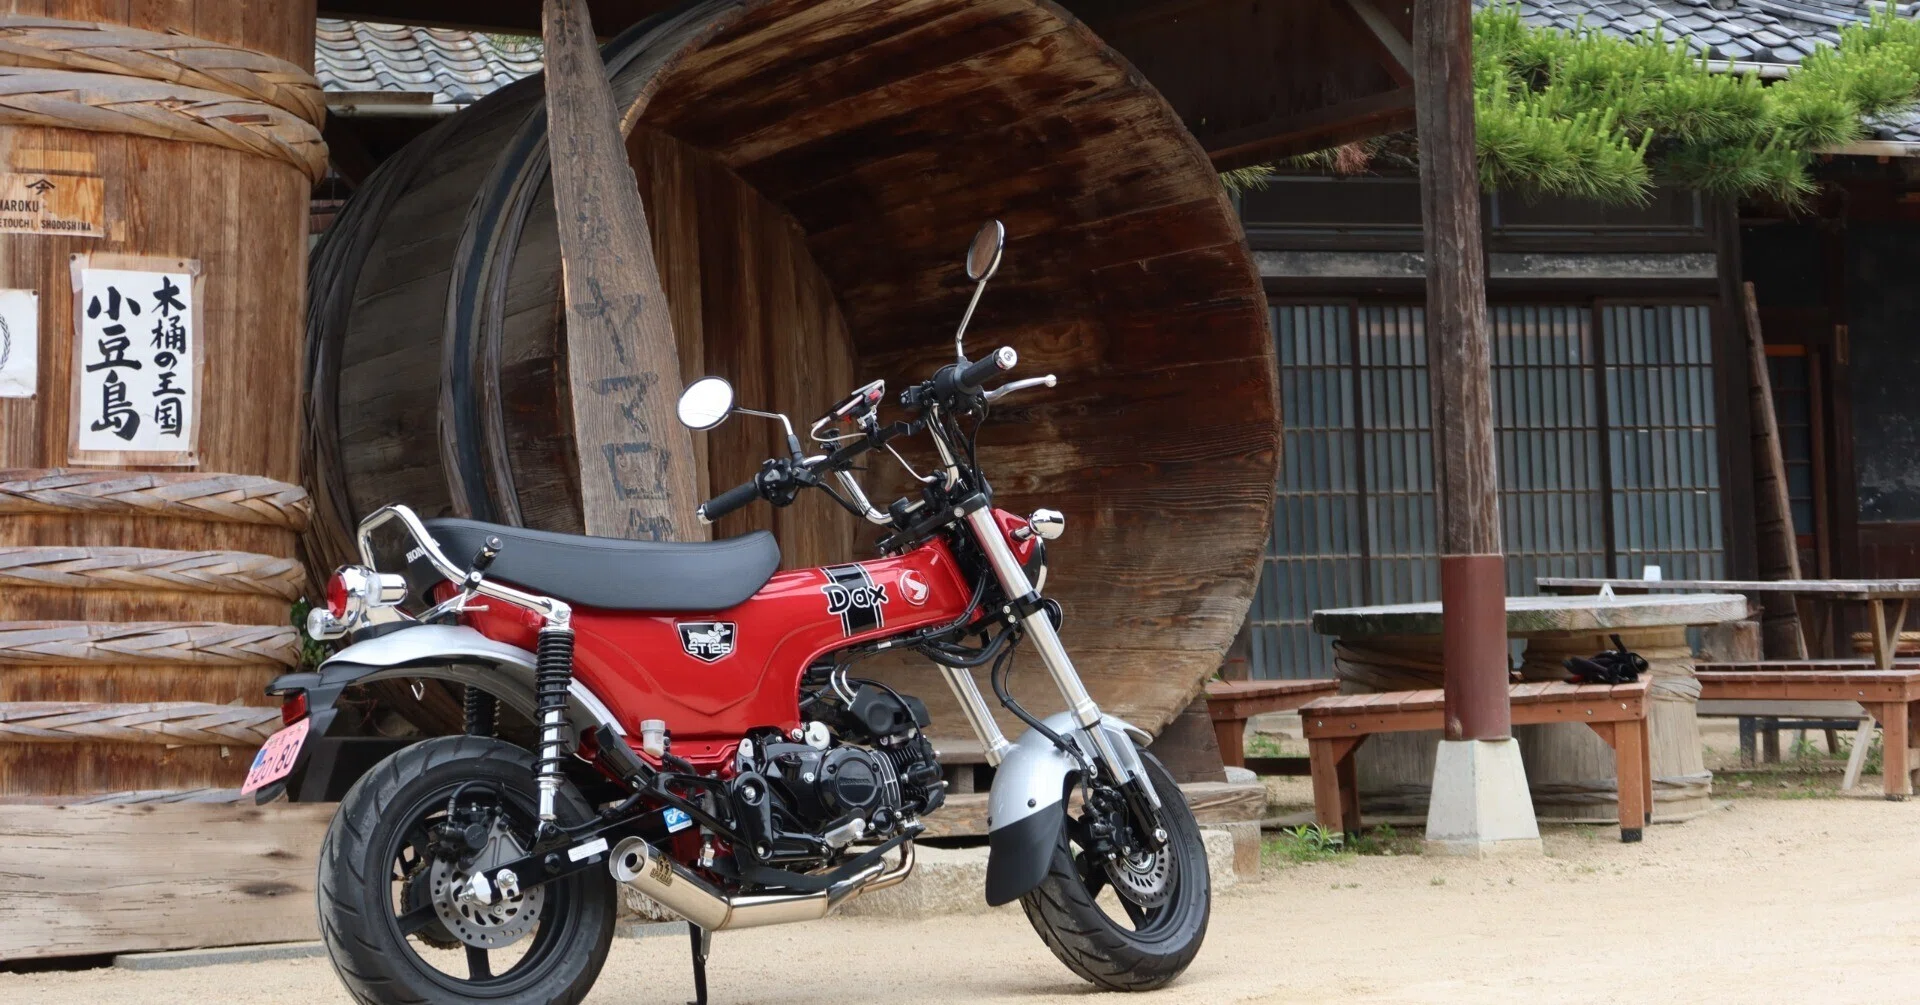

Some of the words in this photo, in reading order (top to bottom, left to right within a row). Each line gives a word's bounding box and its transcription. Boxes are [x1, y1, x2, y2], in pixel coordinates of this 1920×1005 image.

[41, 220, 91, 231] SHODOSHIMA
[86, 286, 142, 441] 小豆島
[151, 276, 187, 438] 木桶の王国
[820, 583, 888, 614] Dax
[688, 642, 731, 654] ST125
